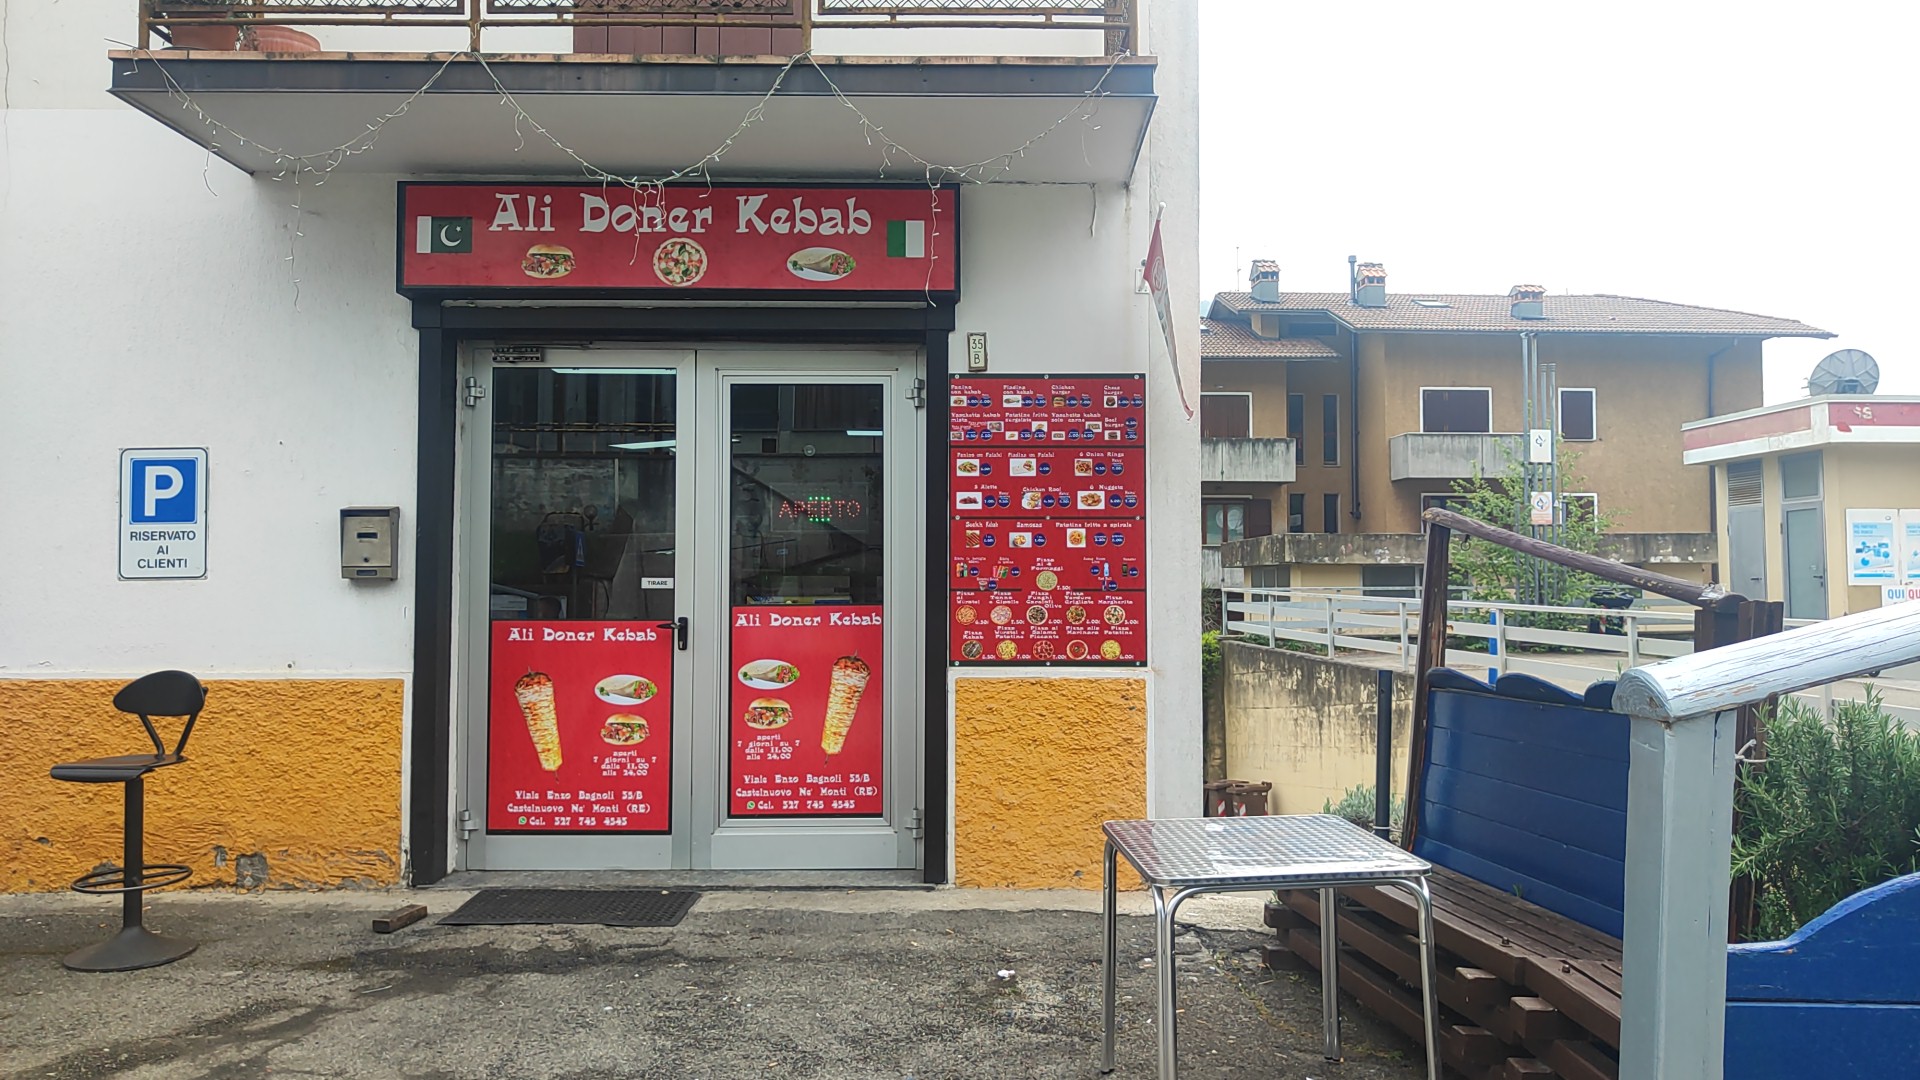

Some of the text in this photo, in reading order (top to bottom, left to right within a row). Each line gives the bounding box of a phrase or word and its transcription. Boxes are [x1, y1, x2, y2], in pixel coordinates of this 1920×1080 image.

[488, 193, 872, 236] Ali Doner Kebab
[972, 339, 983, 350] 35
[974, 353, 981, 364] B
[144, 465, 184, 516] P
[778, 500, 861, 518] APERTO
[130, 530, 196, 541] RISERVATO
[156, 545, 169, 555] AI
[137, 558, 188, 569] CLIENTI
[1887, 589, 1904, 599] QUI
[735, 611, 882, 627] Ali Doner Kebab
[508, 627, 657, 642] Ali Doner Kebab
[749, 740, 773, 748] giorni
[604, 756, 630, 764] giorni
[743, 774, 768, 784] Viale
[774, 774, 799, 783] Enzo
[806, 774, 842, 784] Bagnoli
[515, 790, 539, 800] Viale
[546, 790, 572, 800] Enzo
[578, 790, 614, 801] Bagnoli
[735, 788, 792, 797] Castelnuovo
[820, 787, 847, 796] Monti
[854, 786, 878, 797] (RE)
[507, 803, 564, 813] Castelnuovo
[592, 804, 619, 813] Monti
[626, 803, 651, 814] (RE)
[757, 800, 774, 809] Cel.
[529, 817, 546, 826] Cel.
